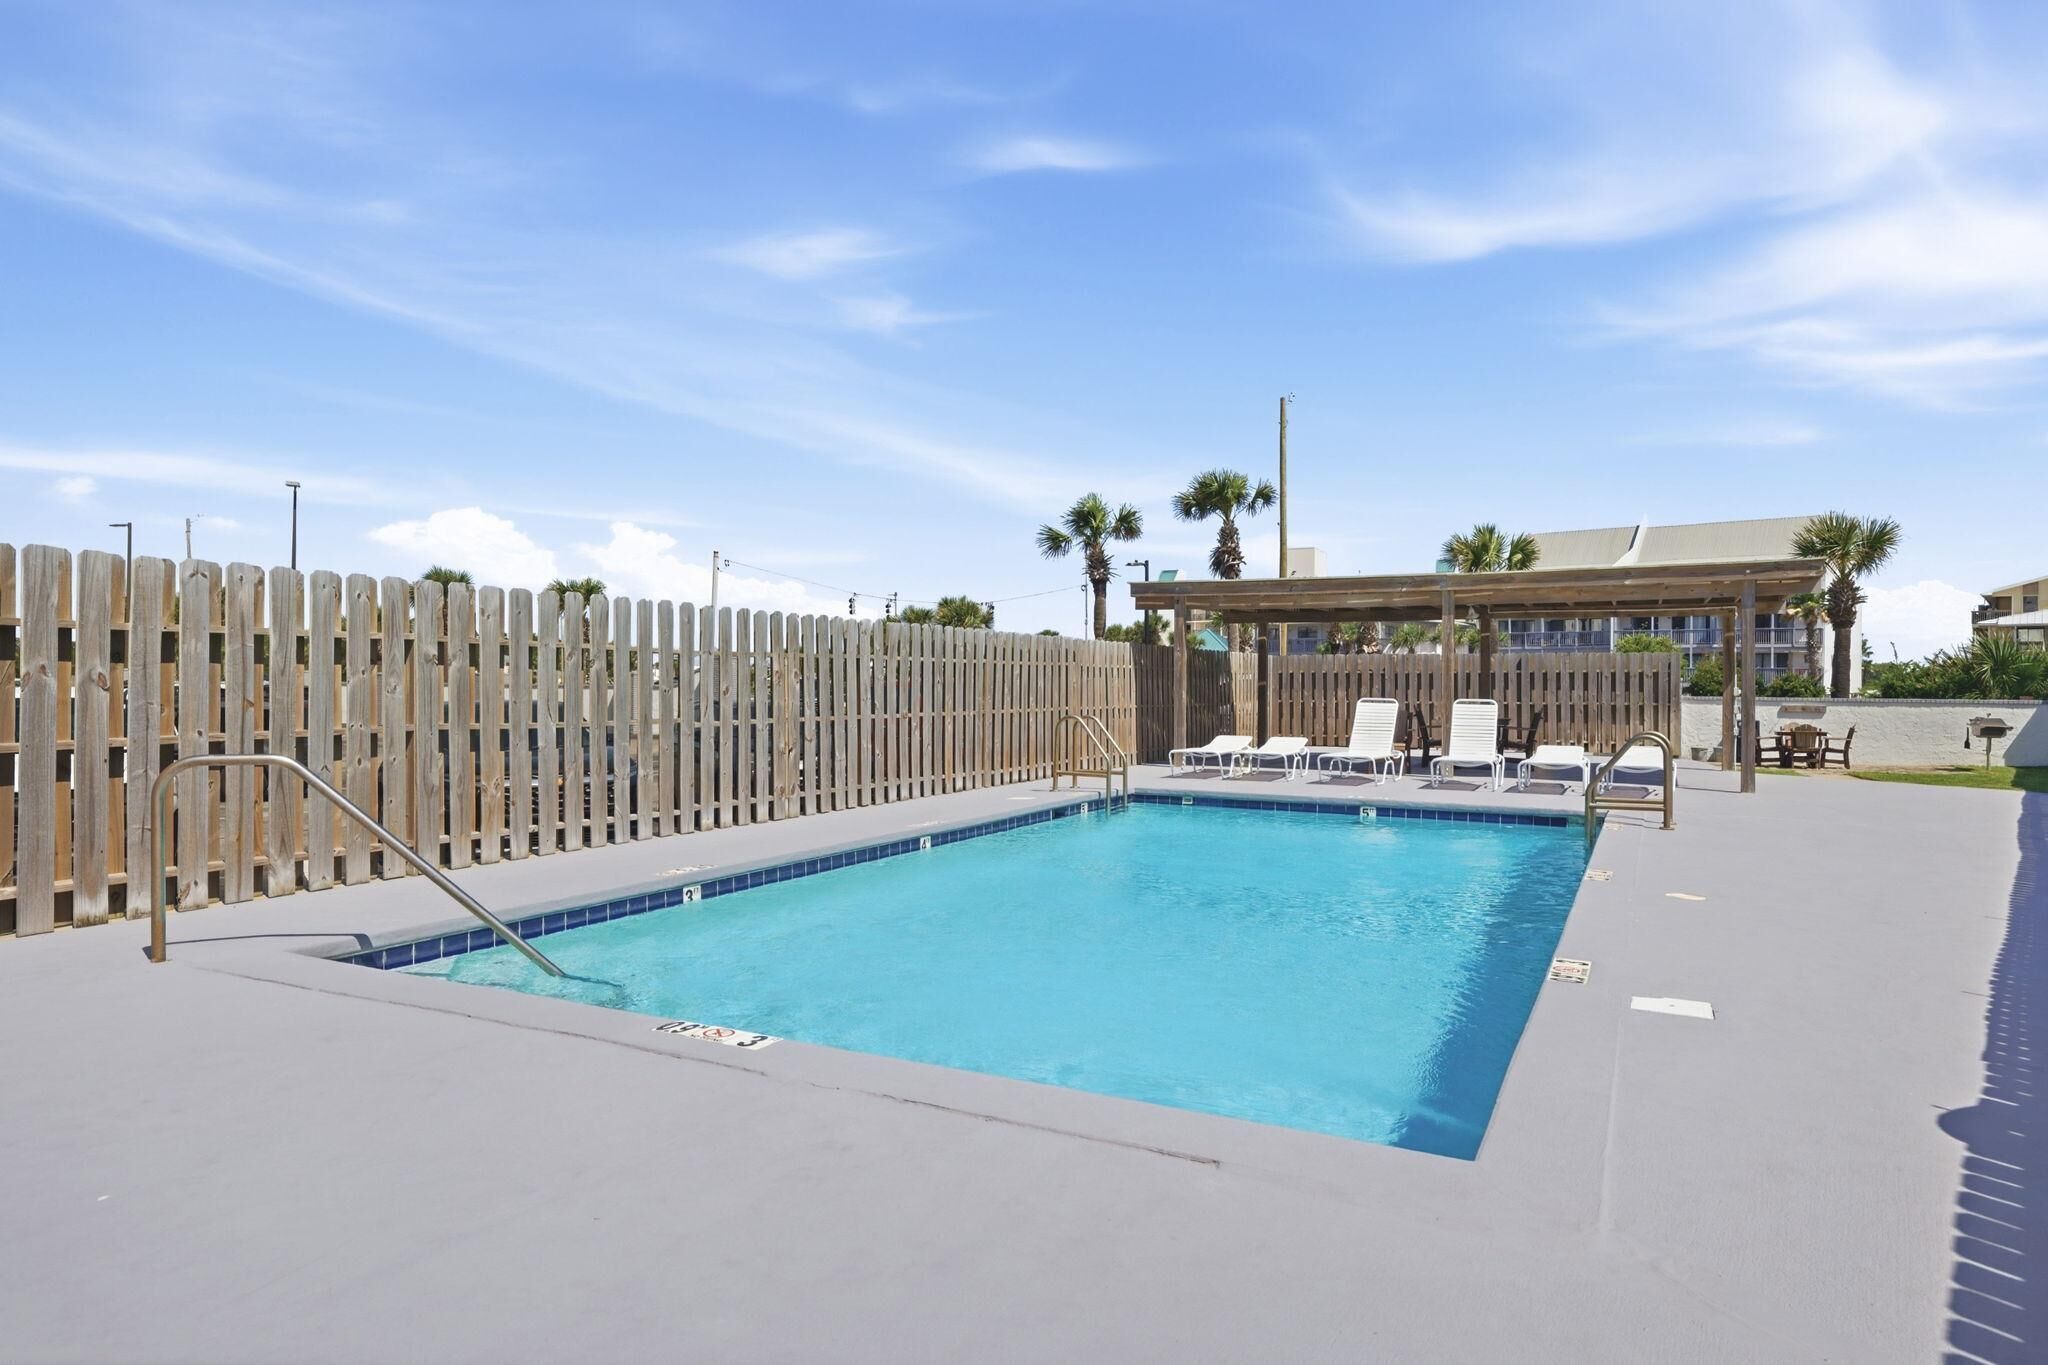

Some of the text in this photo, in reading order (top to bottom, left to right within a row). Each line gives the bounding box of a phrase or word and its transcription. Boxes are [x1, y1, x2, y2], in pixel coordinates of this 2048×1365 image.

[1362, 808, 1369, 816] 5
[685, 889, 694, 902] 3
[737, 1035, 768, 1047] 3
